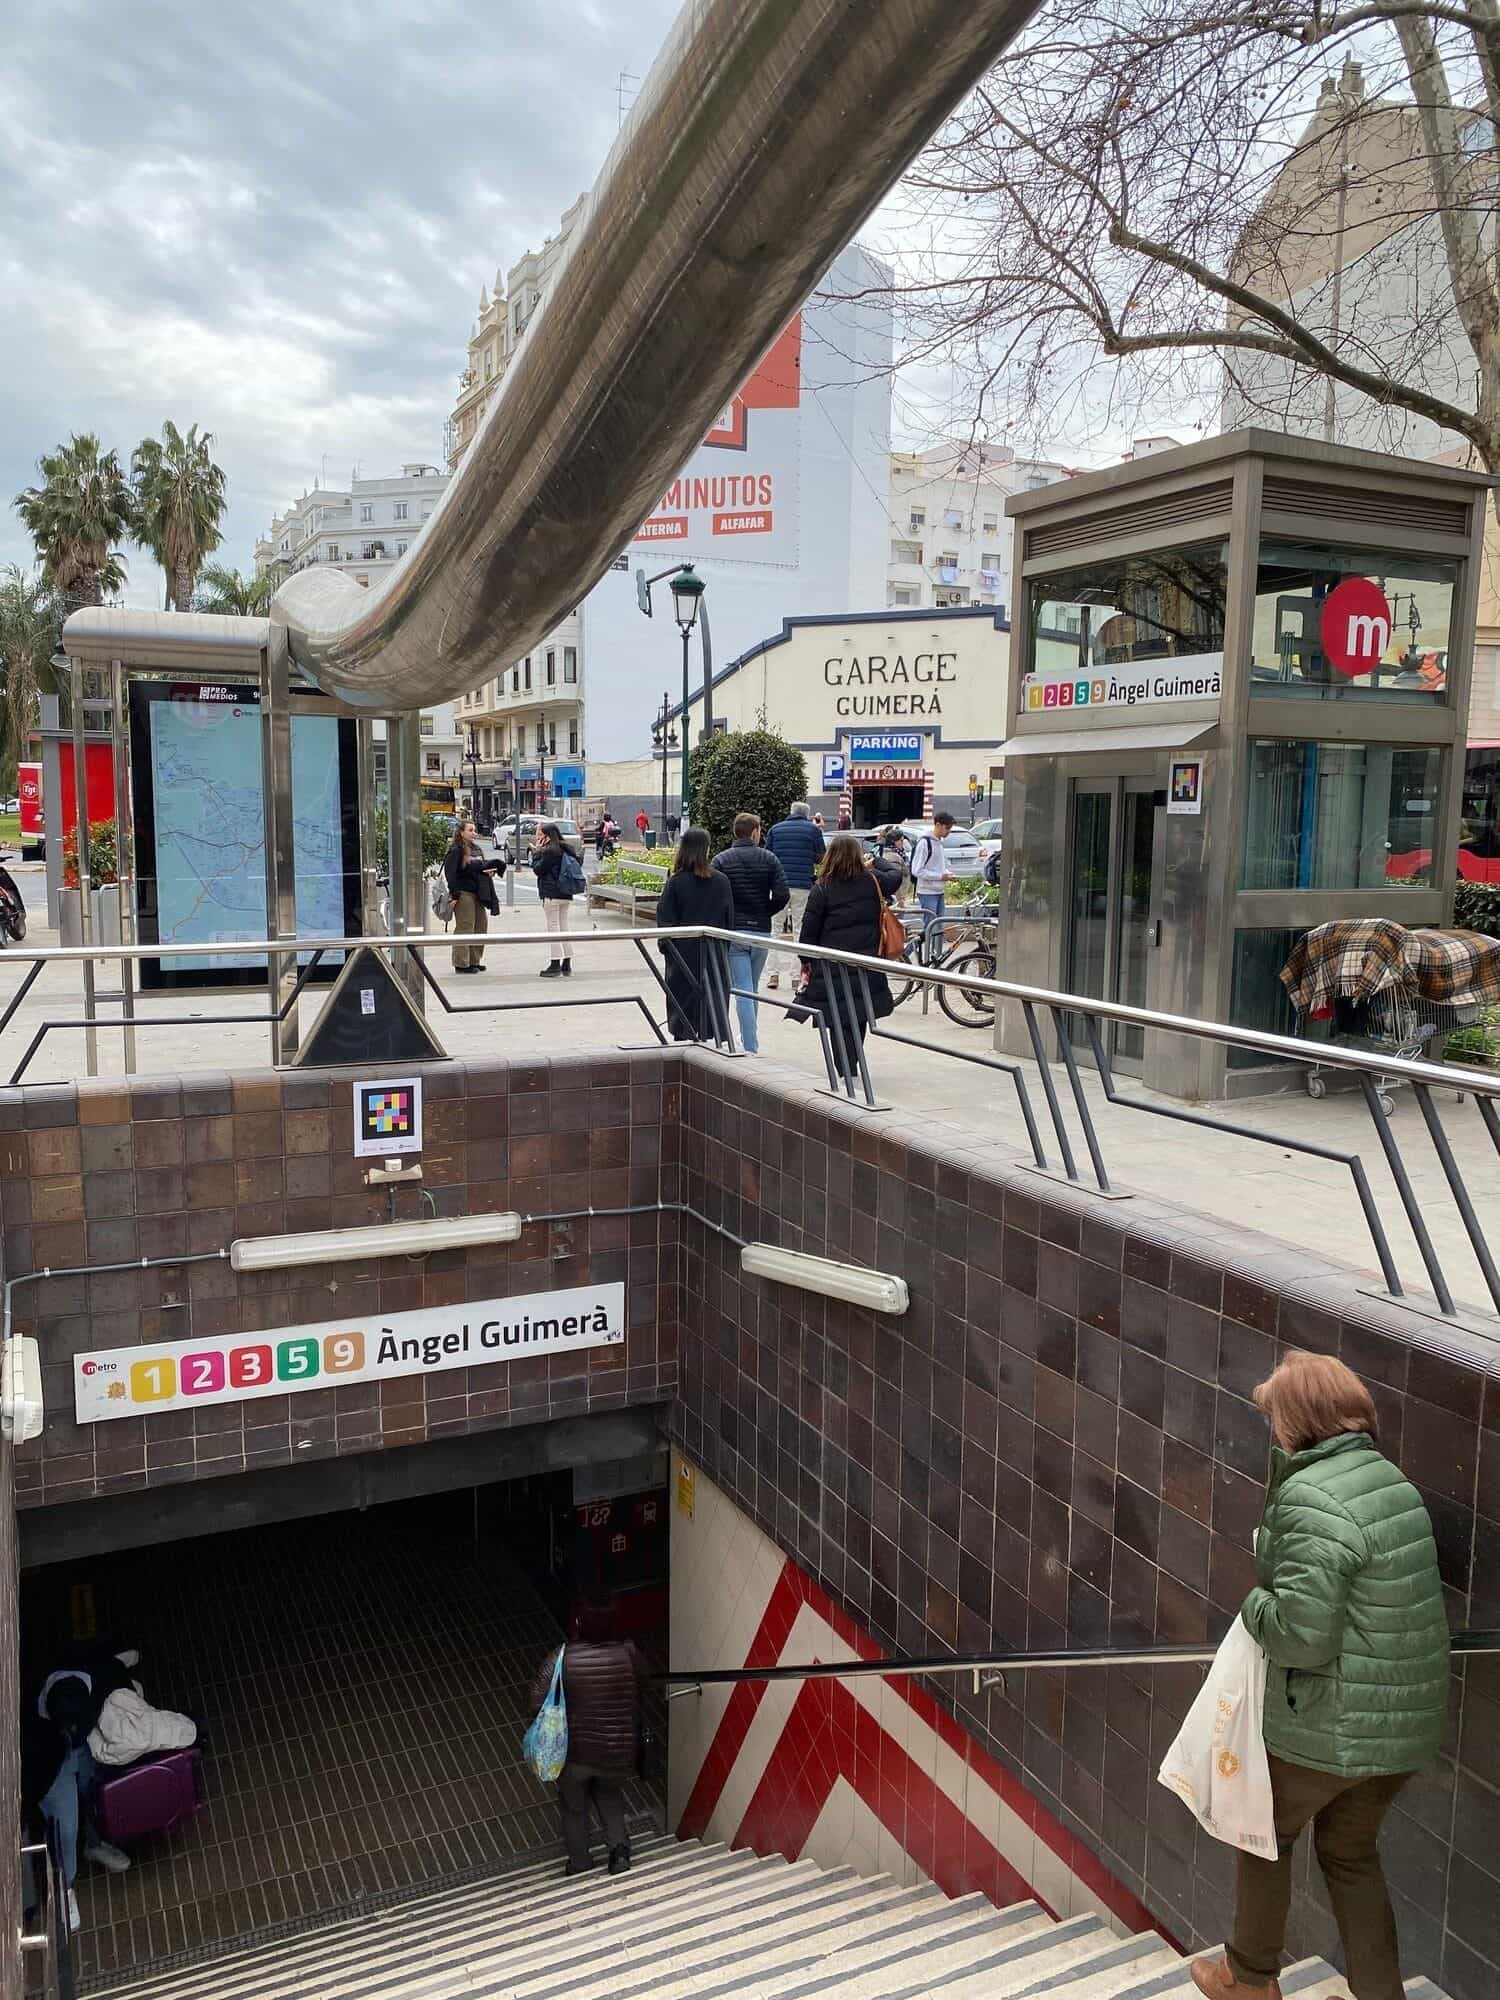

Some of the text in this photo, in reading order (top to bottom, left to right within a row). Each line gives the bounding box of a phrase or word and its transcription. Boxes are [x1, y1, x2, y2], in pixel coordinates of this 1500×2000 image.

[662, 475, 772, 510] MINUTOS
[638, 522, 682, 537] ATERNA
[720, 516, 765, 530] ALFAFAR
[1346, 615, 1389, 658] m
[824, 653, 957, 686] GARAGE
[836, 687, 942, 716] GUIMERÁ
[1047, 688, 1056, 703] 2
[1062, 686, 1071, 702] 3
[1077, 686, 1087, 701] 5
[1108, 676, 1149, 705] Àngel
[1154, 672, 1221, 697] Guimerà
[853, 737, 918, 749] PARKING
[824, 756, 844, 777] P
[144, 1366, 161, 1395] 1
[192, 1359, 213, 1389] 2
[241, 1352, 261, 1381] 3
[288, 1346, 308, 1374] 5
[333, 1339, 354, 1367] 9
[377, 1328, 469, 1365] Àngel
[480, 1304, 609, 1349] Guimerà
